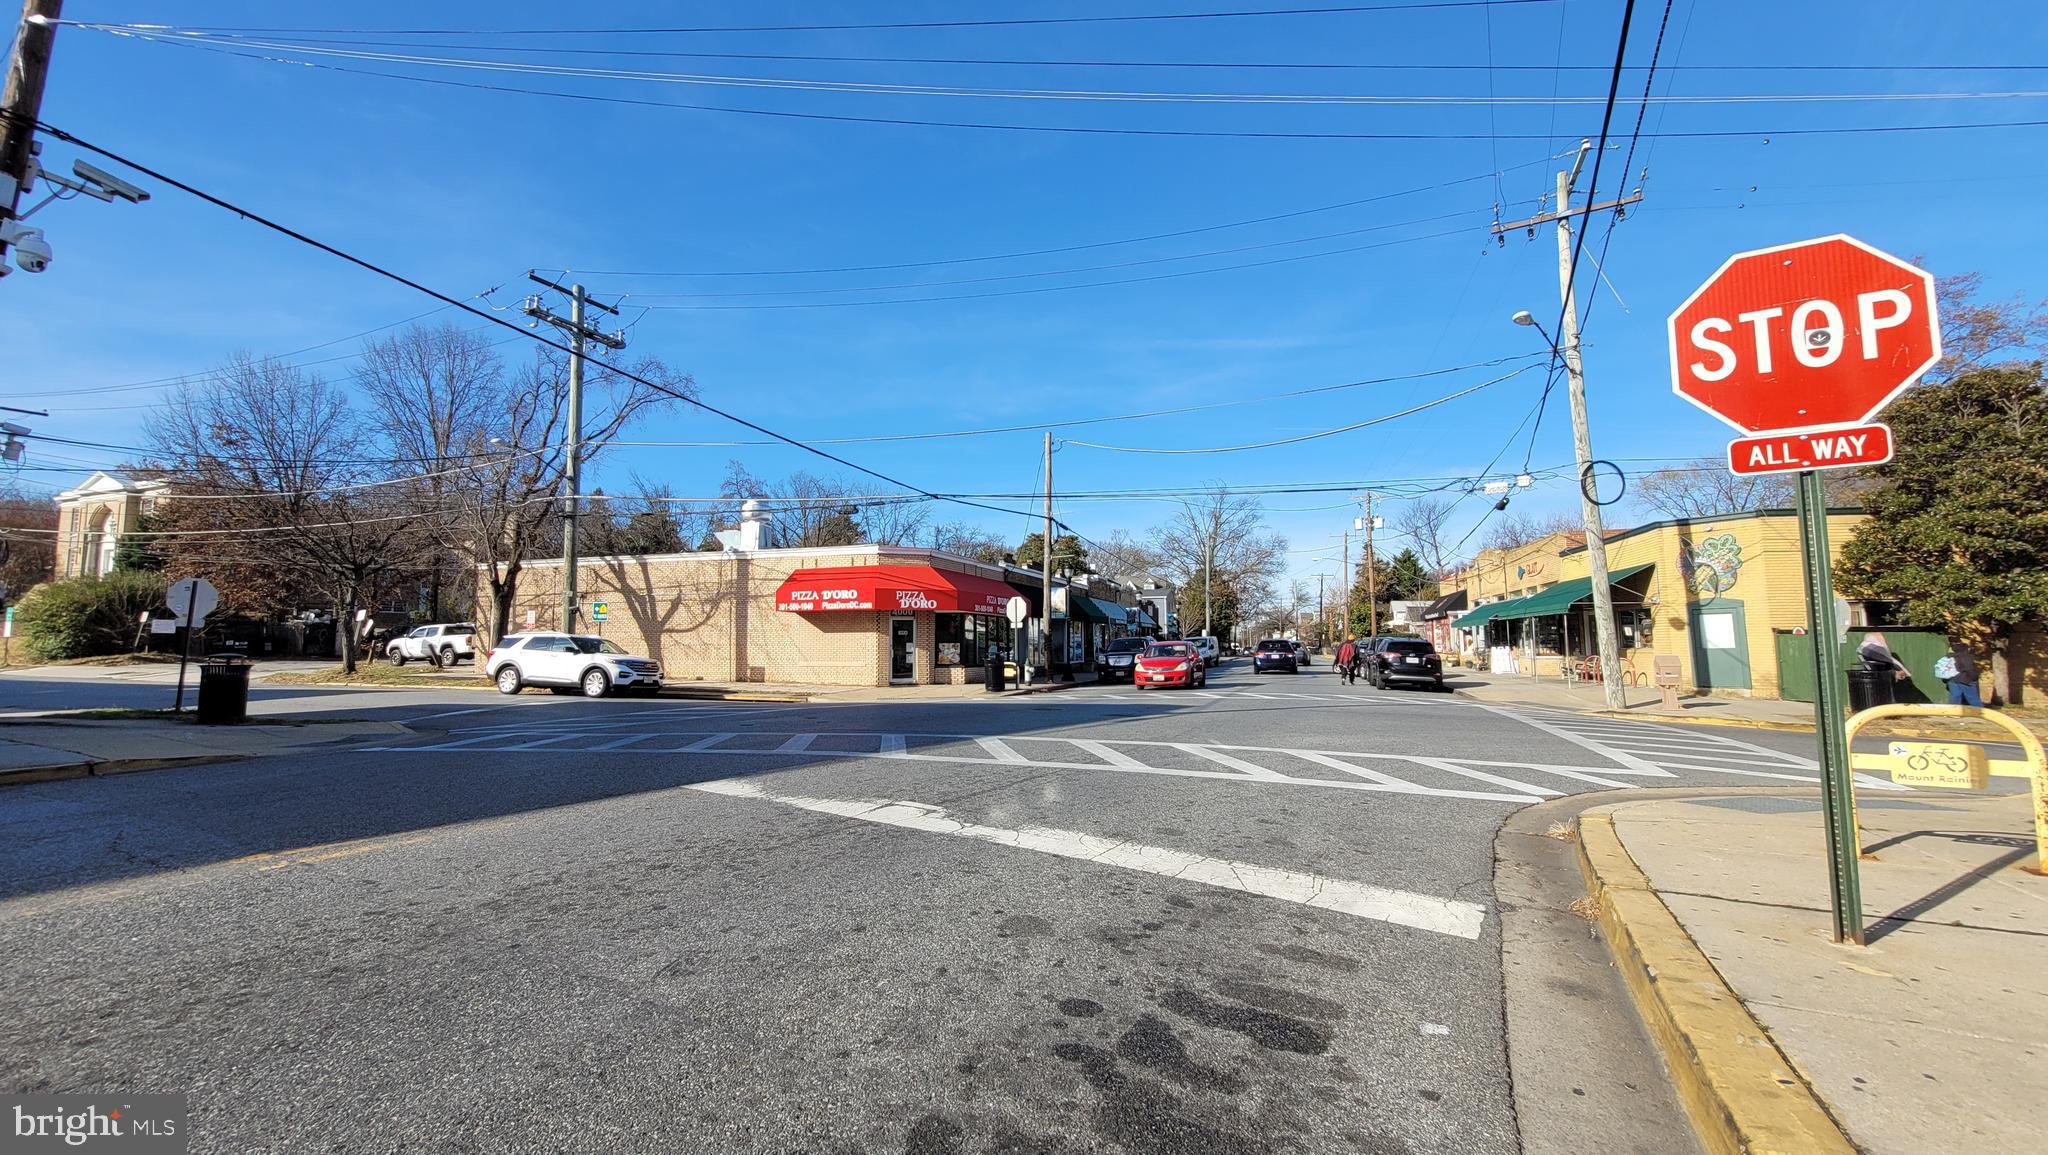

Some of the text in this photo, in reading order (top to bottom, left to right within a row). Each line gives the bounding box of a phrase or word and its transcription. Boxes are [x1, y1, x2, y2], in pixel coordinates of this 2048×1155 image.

[1690, 289, 1912, 382] STOP
[1749, 434, 1867, 467] ALL WAY
[791, 589, 858, 600] PIZZA D'ORO
[896, 590, 926, 600] PIZZA
[899, 599, 937, 609] D'ORO
[1897, 773, 1934, 782] Mount
